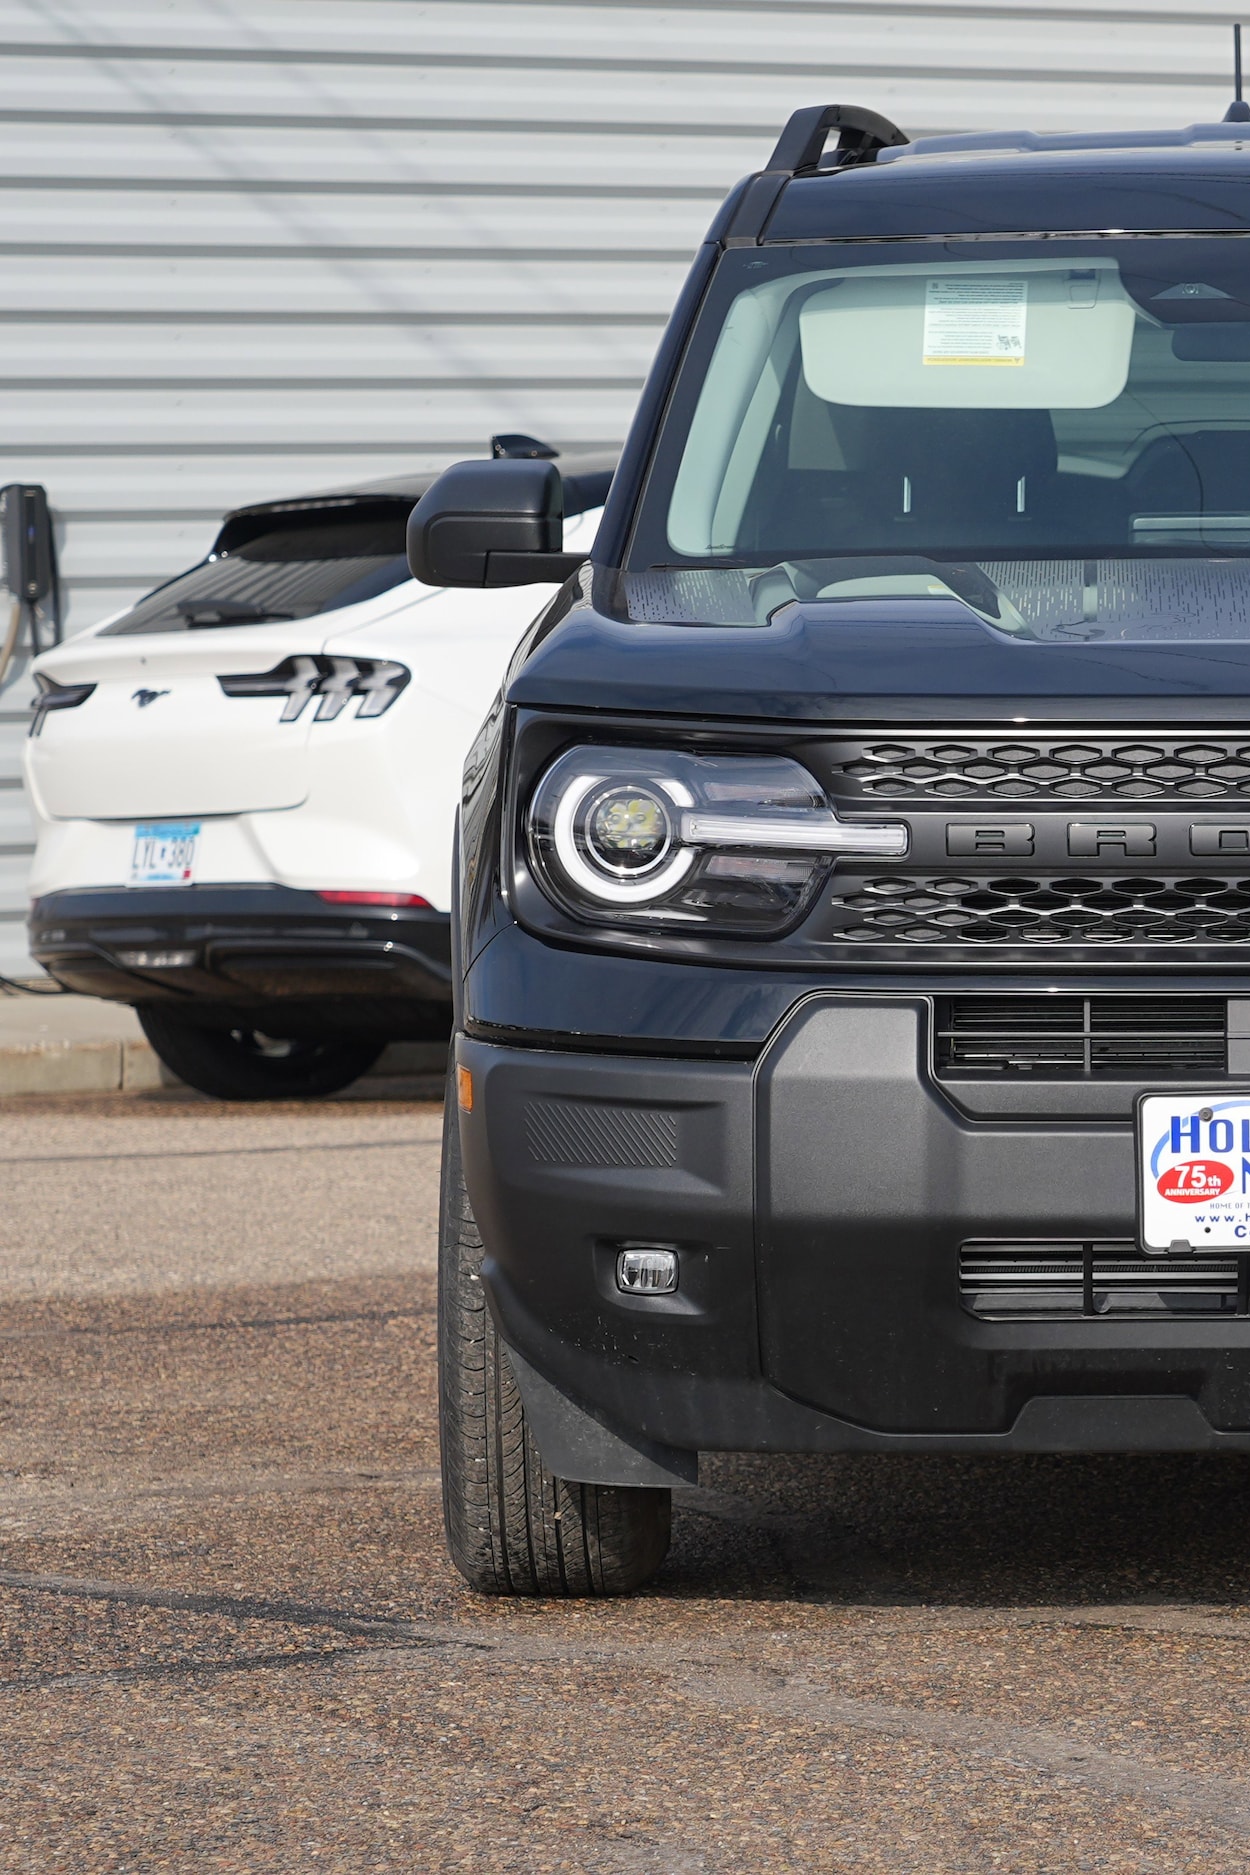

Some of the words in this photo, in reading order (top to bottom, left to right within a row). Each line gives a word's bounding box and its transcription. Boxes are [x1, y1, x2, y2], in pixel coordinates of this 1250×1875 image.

[1174, 1165, 1222, 1188] 75th
[1164, 1187, 1221, 1197] ANNIVERSARY
[1209, 1202, 1232, 1210] HOME
[1234, 1202, 1244, 1210] OF
